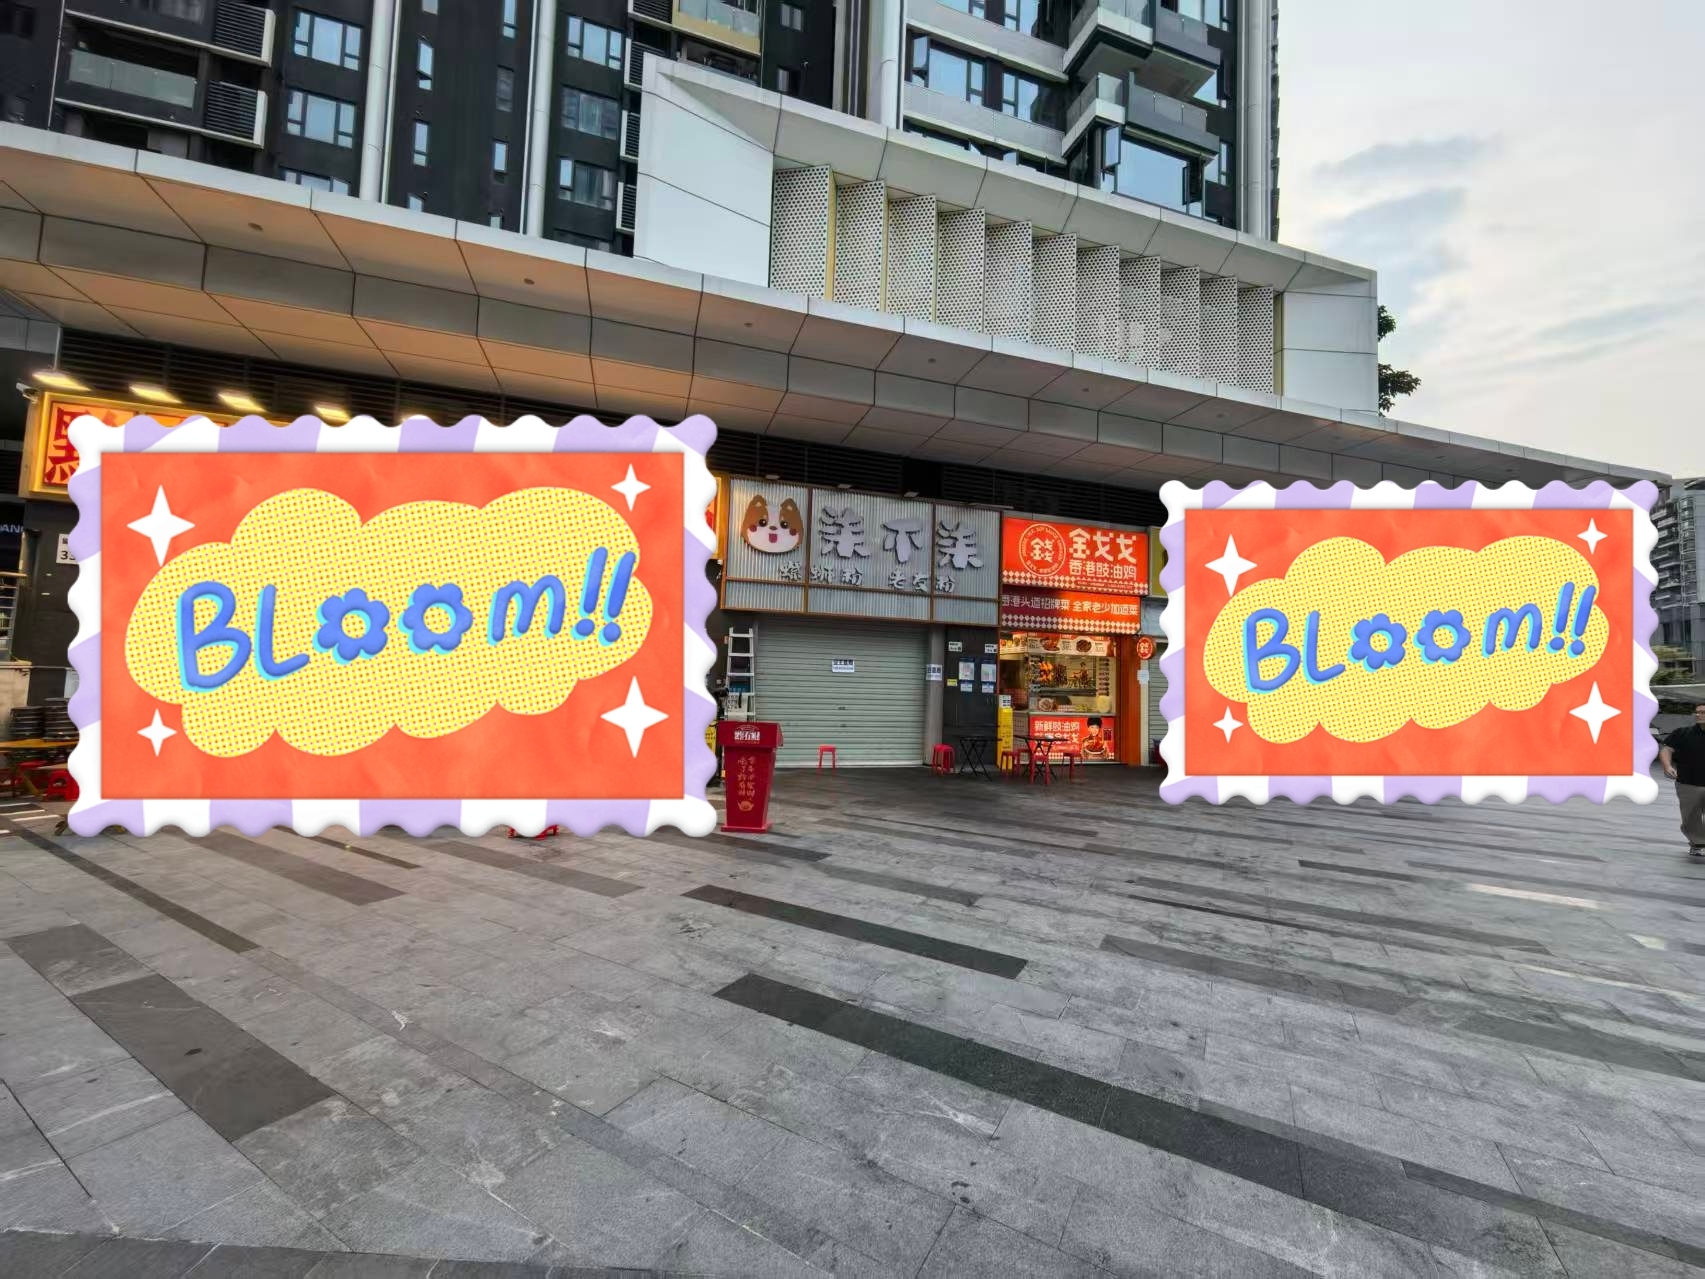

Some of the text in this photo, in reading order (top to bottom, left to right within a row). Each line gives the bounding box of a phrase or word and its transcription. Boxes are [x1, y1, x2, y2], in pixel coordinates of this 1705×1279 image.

[1069, 559, 1136, 580] 香港豉油鸡
